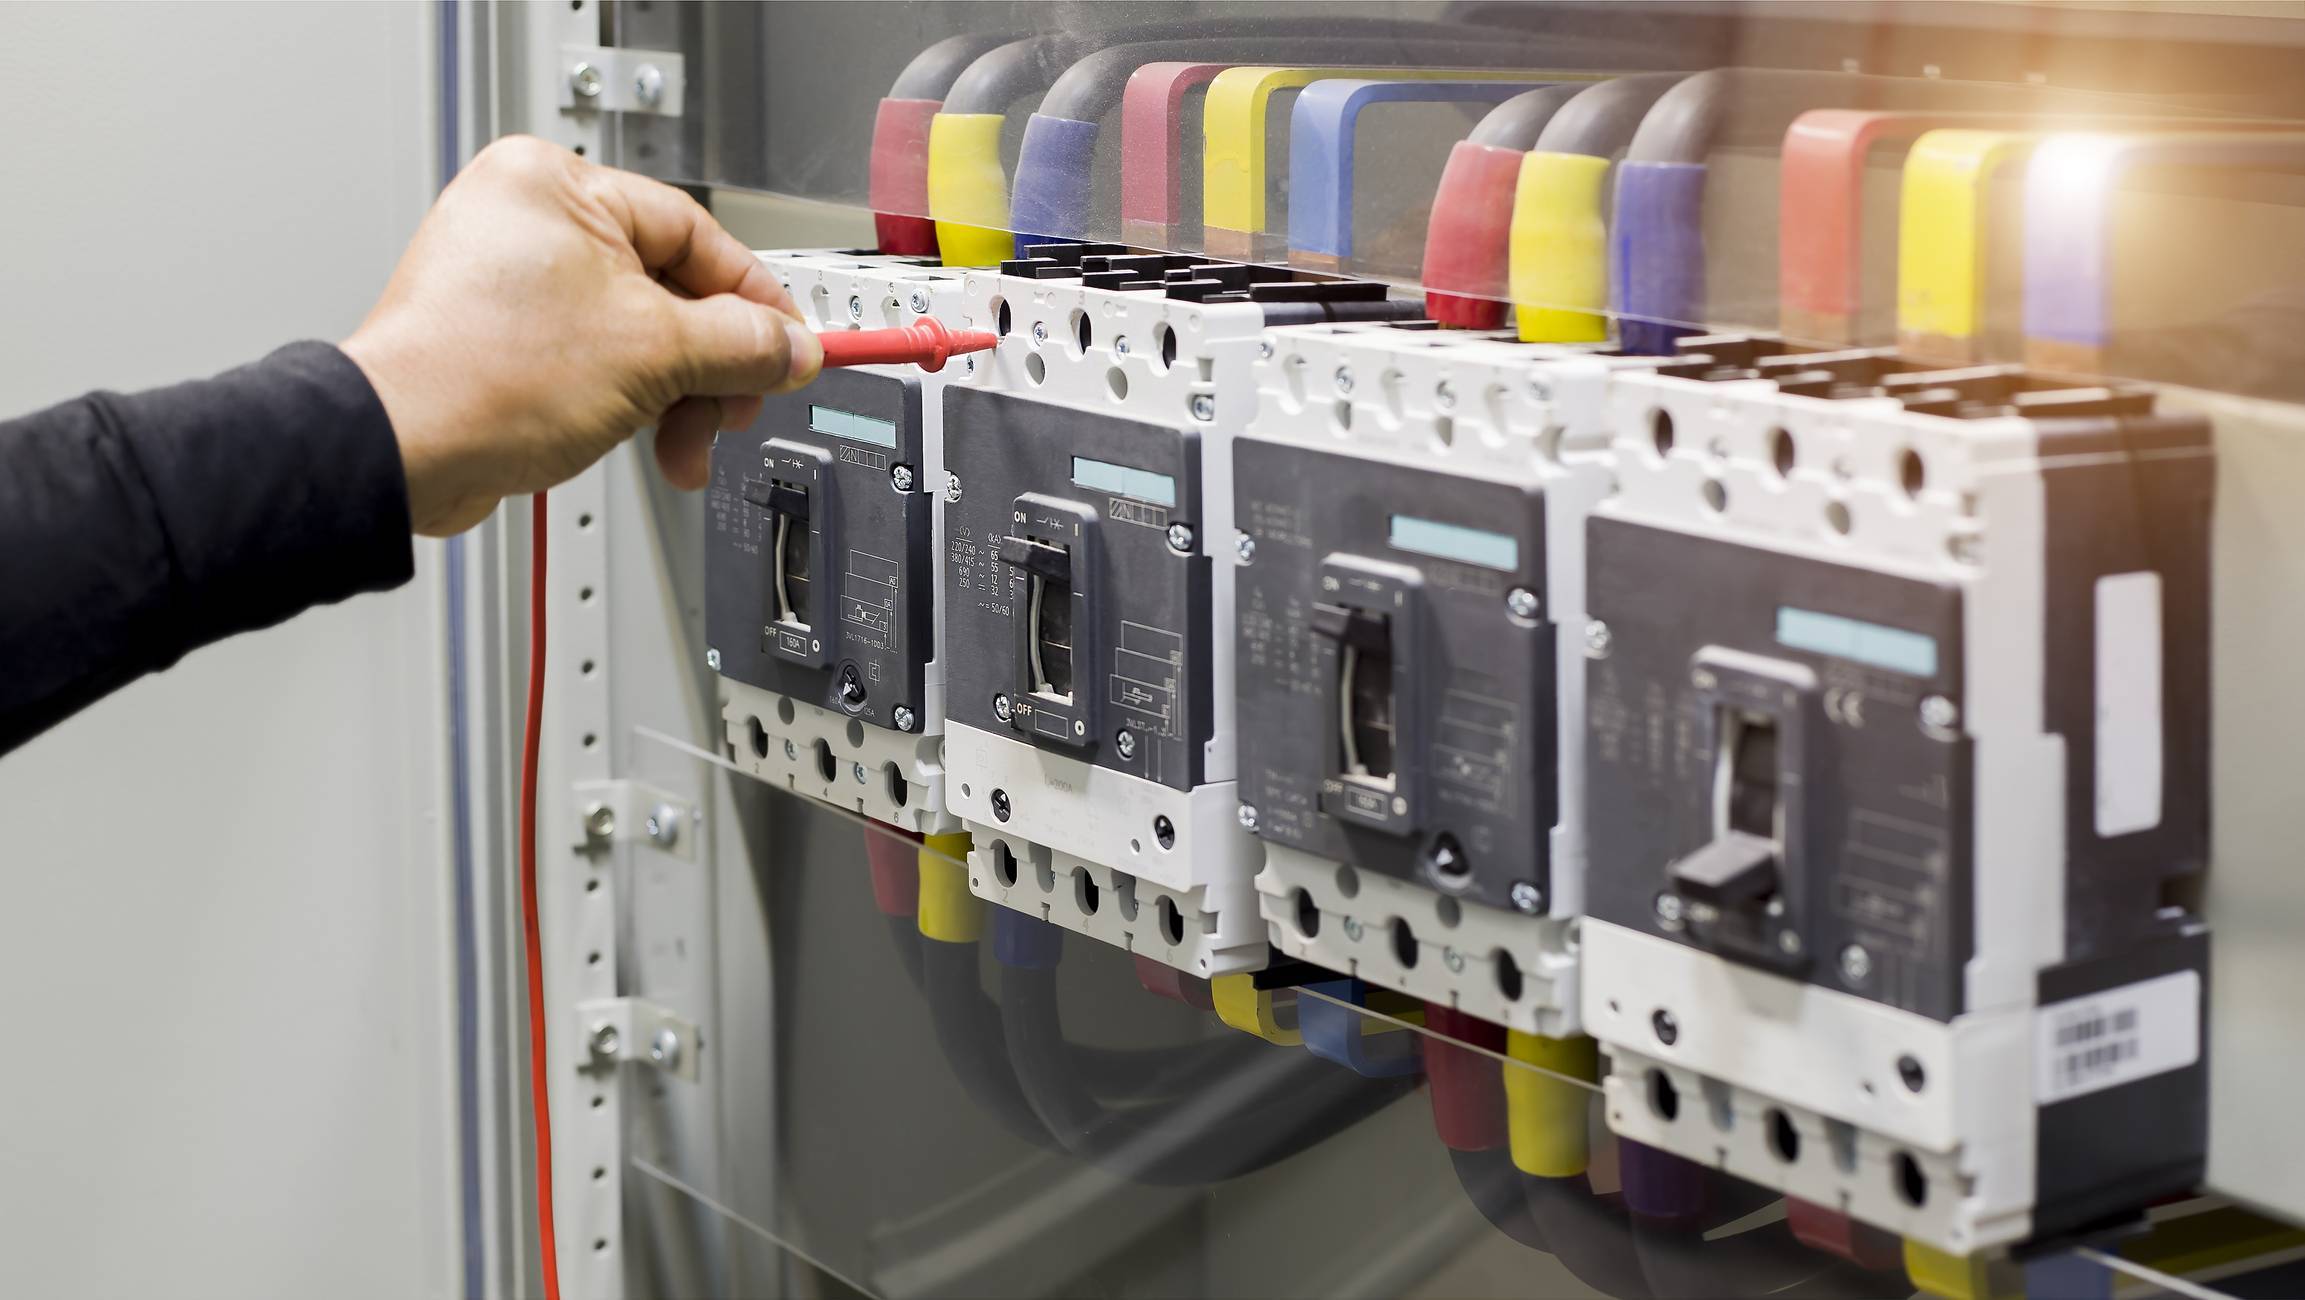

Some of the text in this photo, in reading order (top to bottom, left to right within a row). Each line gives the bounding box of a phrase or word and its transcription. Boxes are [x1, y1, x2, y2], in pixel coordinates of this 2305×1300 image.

[764, 457, 775, 469] ON
[1014, 511, 1027, 524] ON
[951, 540, 999, 561] 220/240 65
[951, 552, 975, 567] 380/415
[958, 566, 970, 578] 690
[991, 574, 998, 585] 12
[959, 577, 970, 589] 250
[764, 625, 777, 638] OFF
[1016, 702, 1033, 717] OFF
